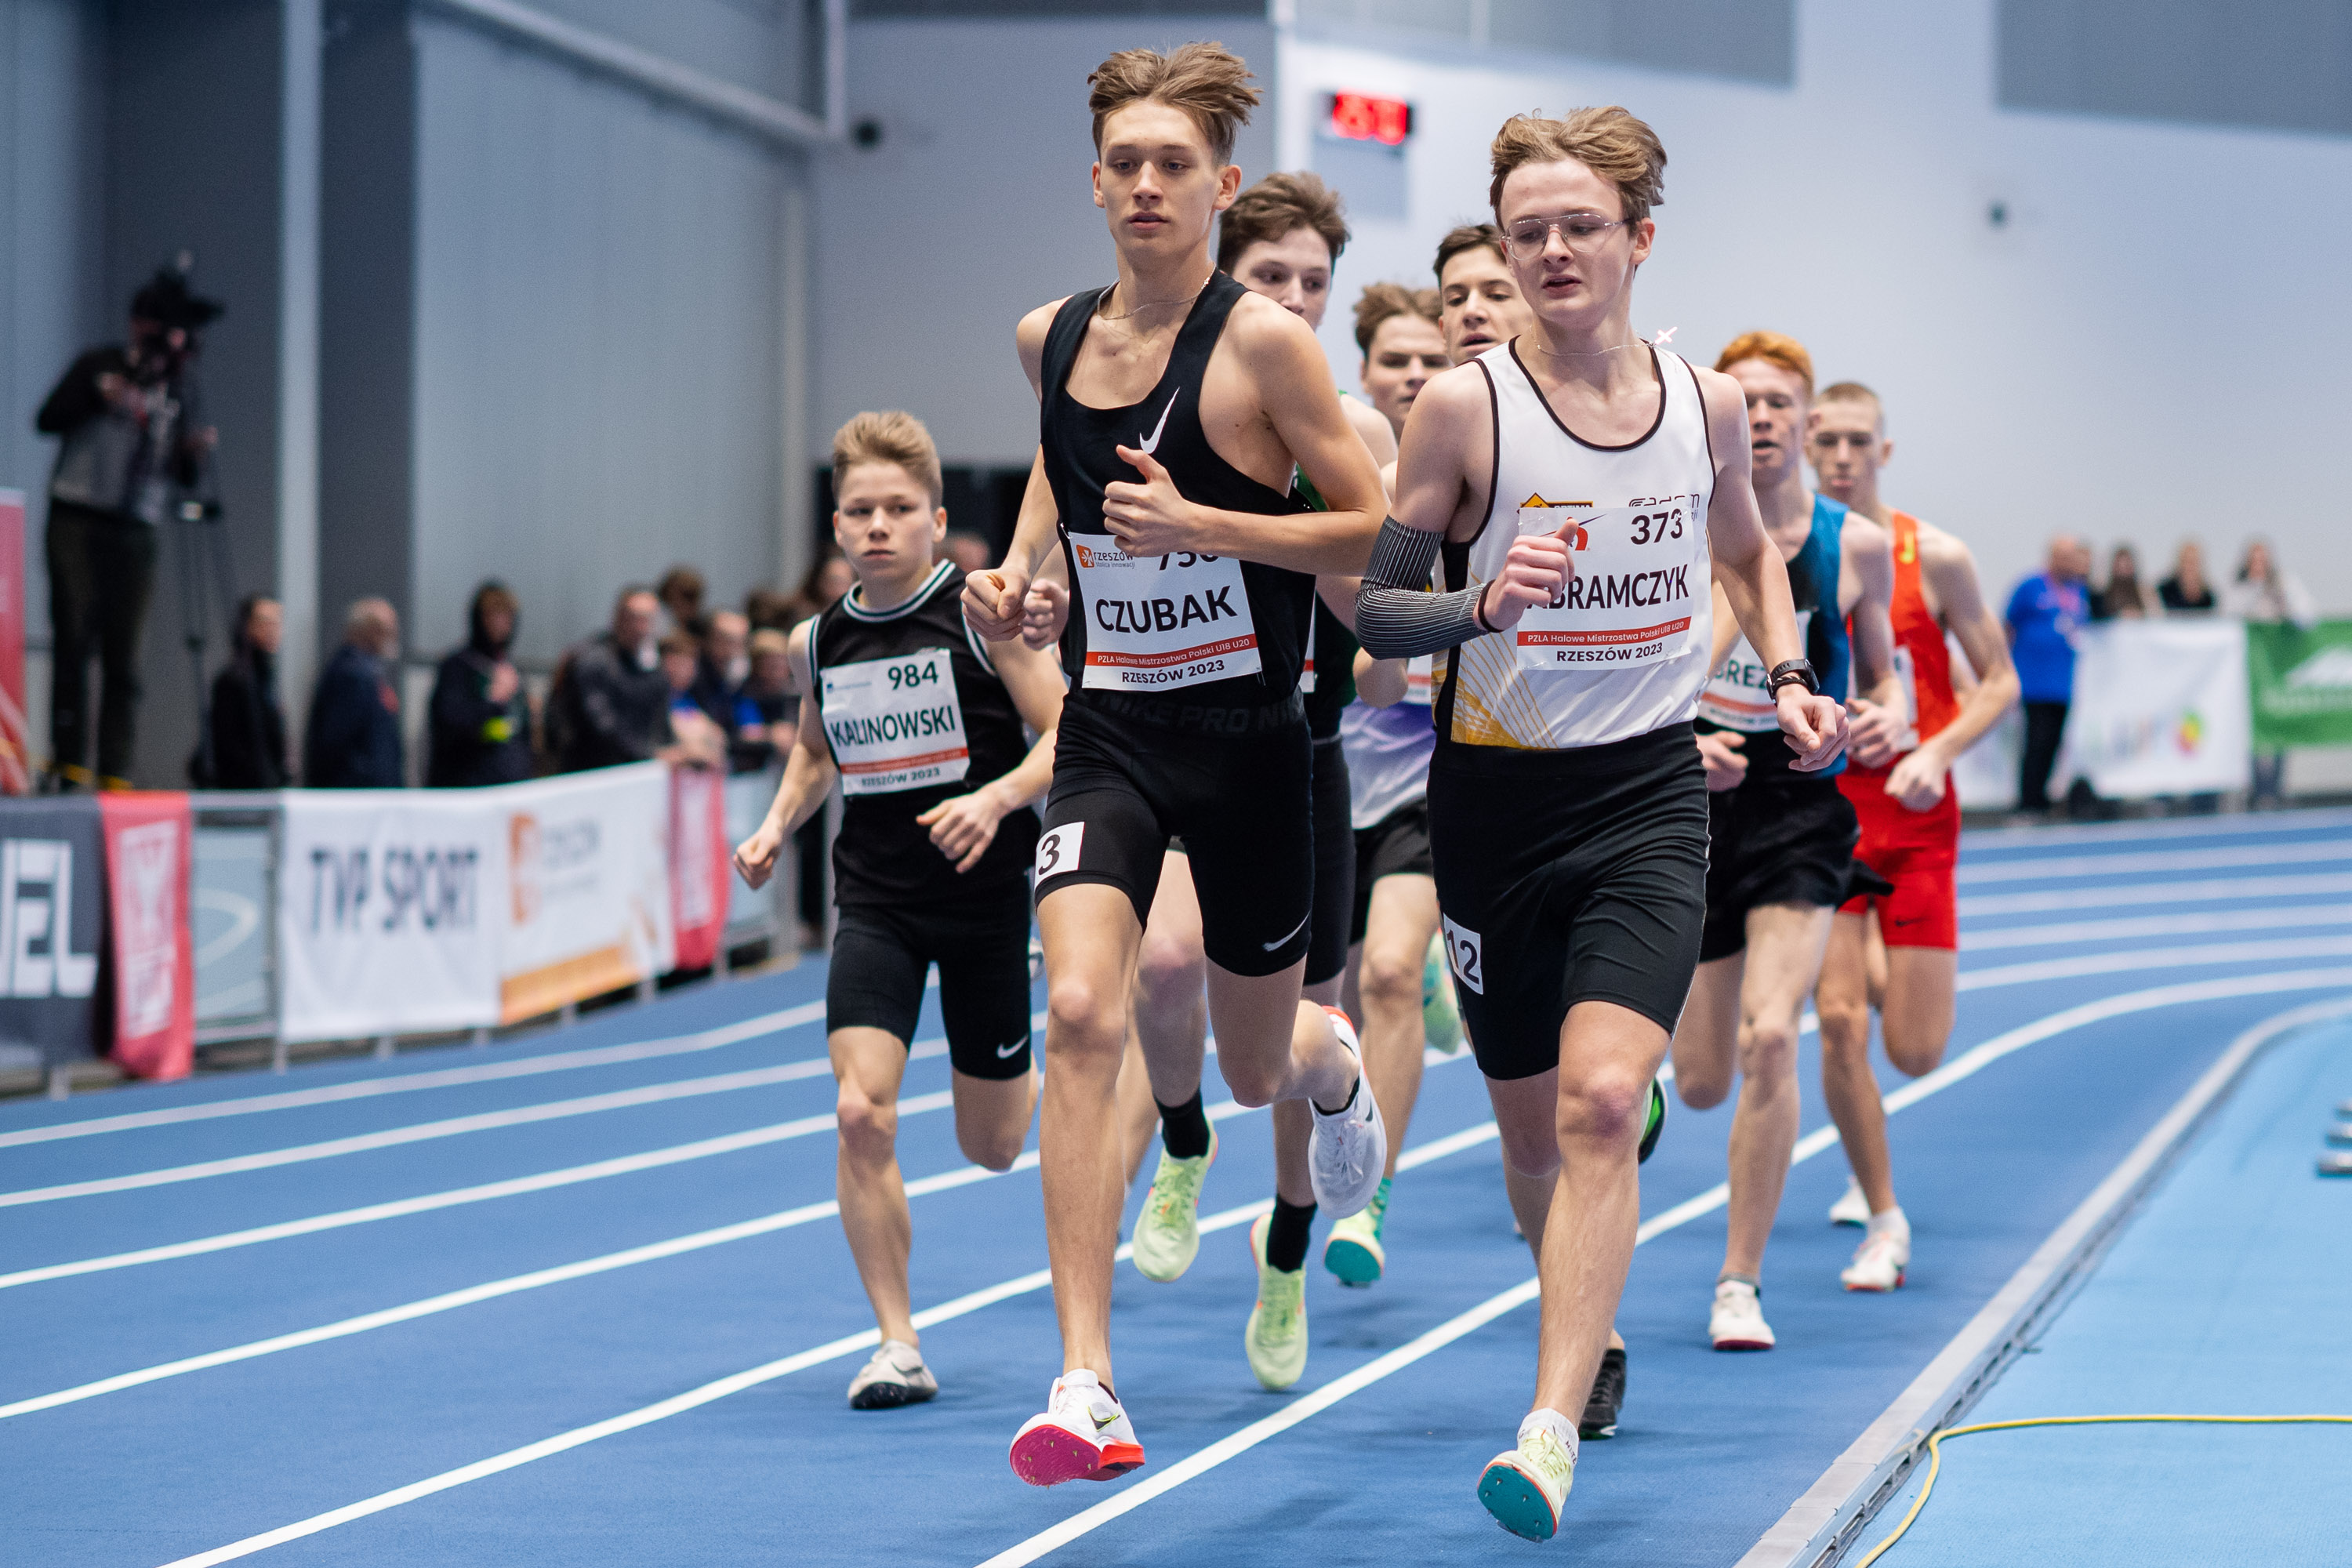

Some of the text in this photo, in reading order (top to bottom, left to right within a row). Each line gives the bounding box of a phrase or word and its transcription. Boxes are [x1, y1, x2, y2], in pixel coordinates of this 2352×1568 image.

[1631, 508, 1682, 545] 373
[1526, 564, 1689, 609] RAMCZYK
[1095, 585, 1238, 633] CZUBAK
[1527, 621, 1684, 643] PZLA Halowe Mistrzostwa Polski U18 U20
[1138, 653, 1187, 665] Mistrzostwa
[1189, 646, 1214, 659] Polski
[1215, 643, 1230, 652] U18
[1233, 638, 1250, 648] U20
[1556, 642, 1663, 662] RZESZÓW 2023
[887, 661, 939, 691] 984
[1122, 659, 1225, 684] RZESZÓW 2023
[829, 705, 956, 747] KALINOWSKI
[911, 767, 941, 781] 2023
[1039, 834, 1061, 875] 3
[310, 844, 481, 933] TVP SPORT
[1446, 929, 1479, 985] 12
